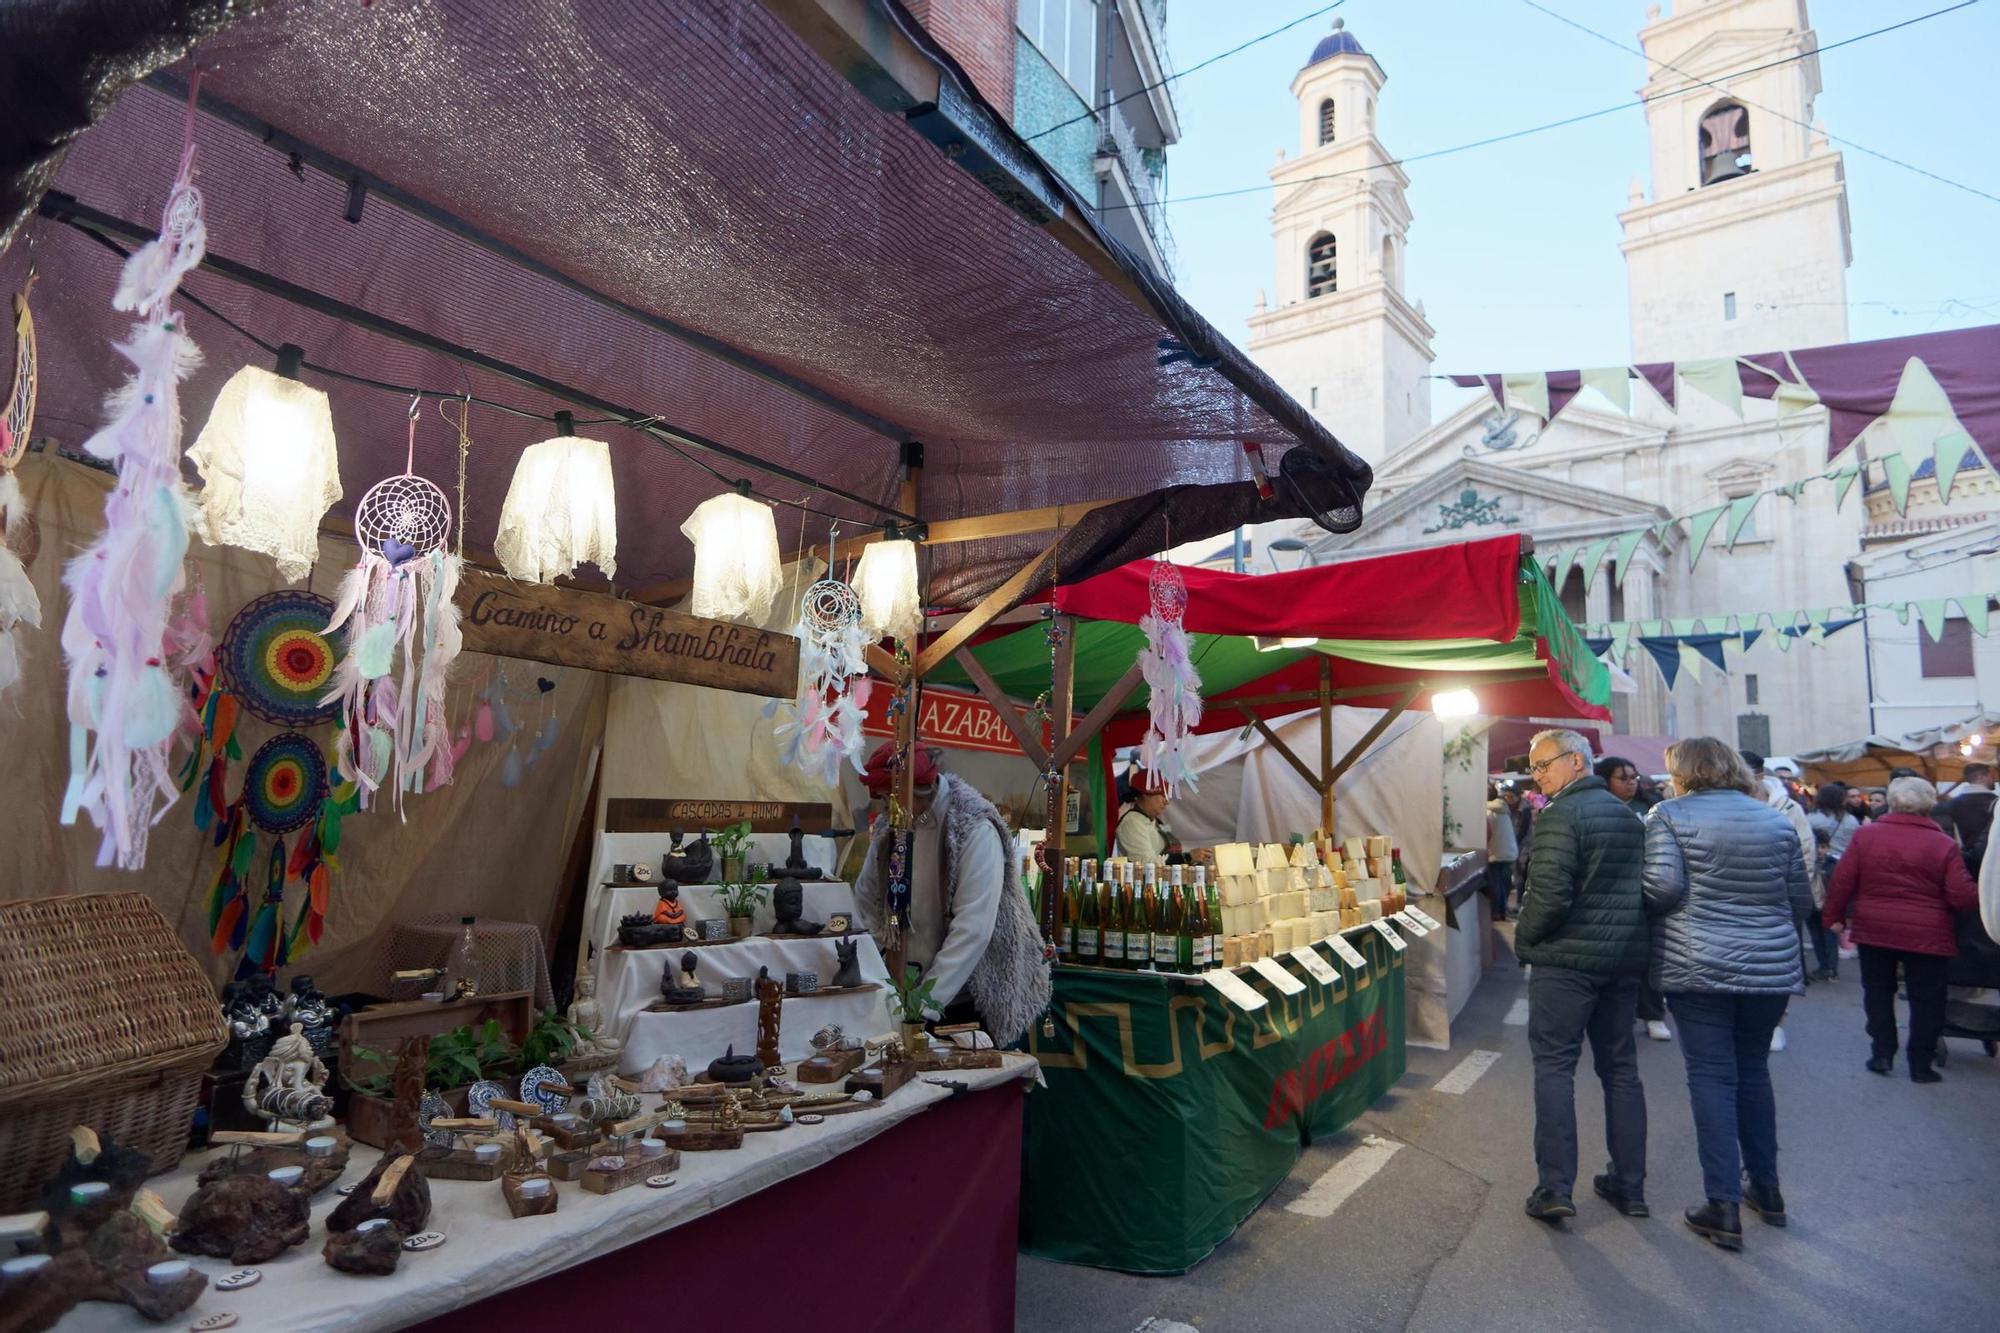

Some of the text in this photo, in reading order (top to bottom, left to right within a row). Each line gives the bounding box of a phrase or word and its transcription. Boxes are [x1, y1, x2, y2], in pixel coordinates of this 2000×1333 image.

[470, 590, 777, 674] Camino a Shambhala
[671, 801, 731, 820] CASCADAS
[404, 1233, 440, 1248] 20€
[220, 1267, 257, 1285] 20€
